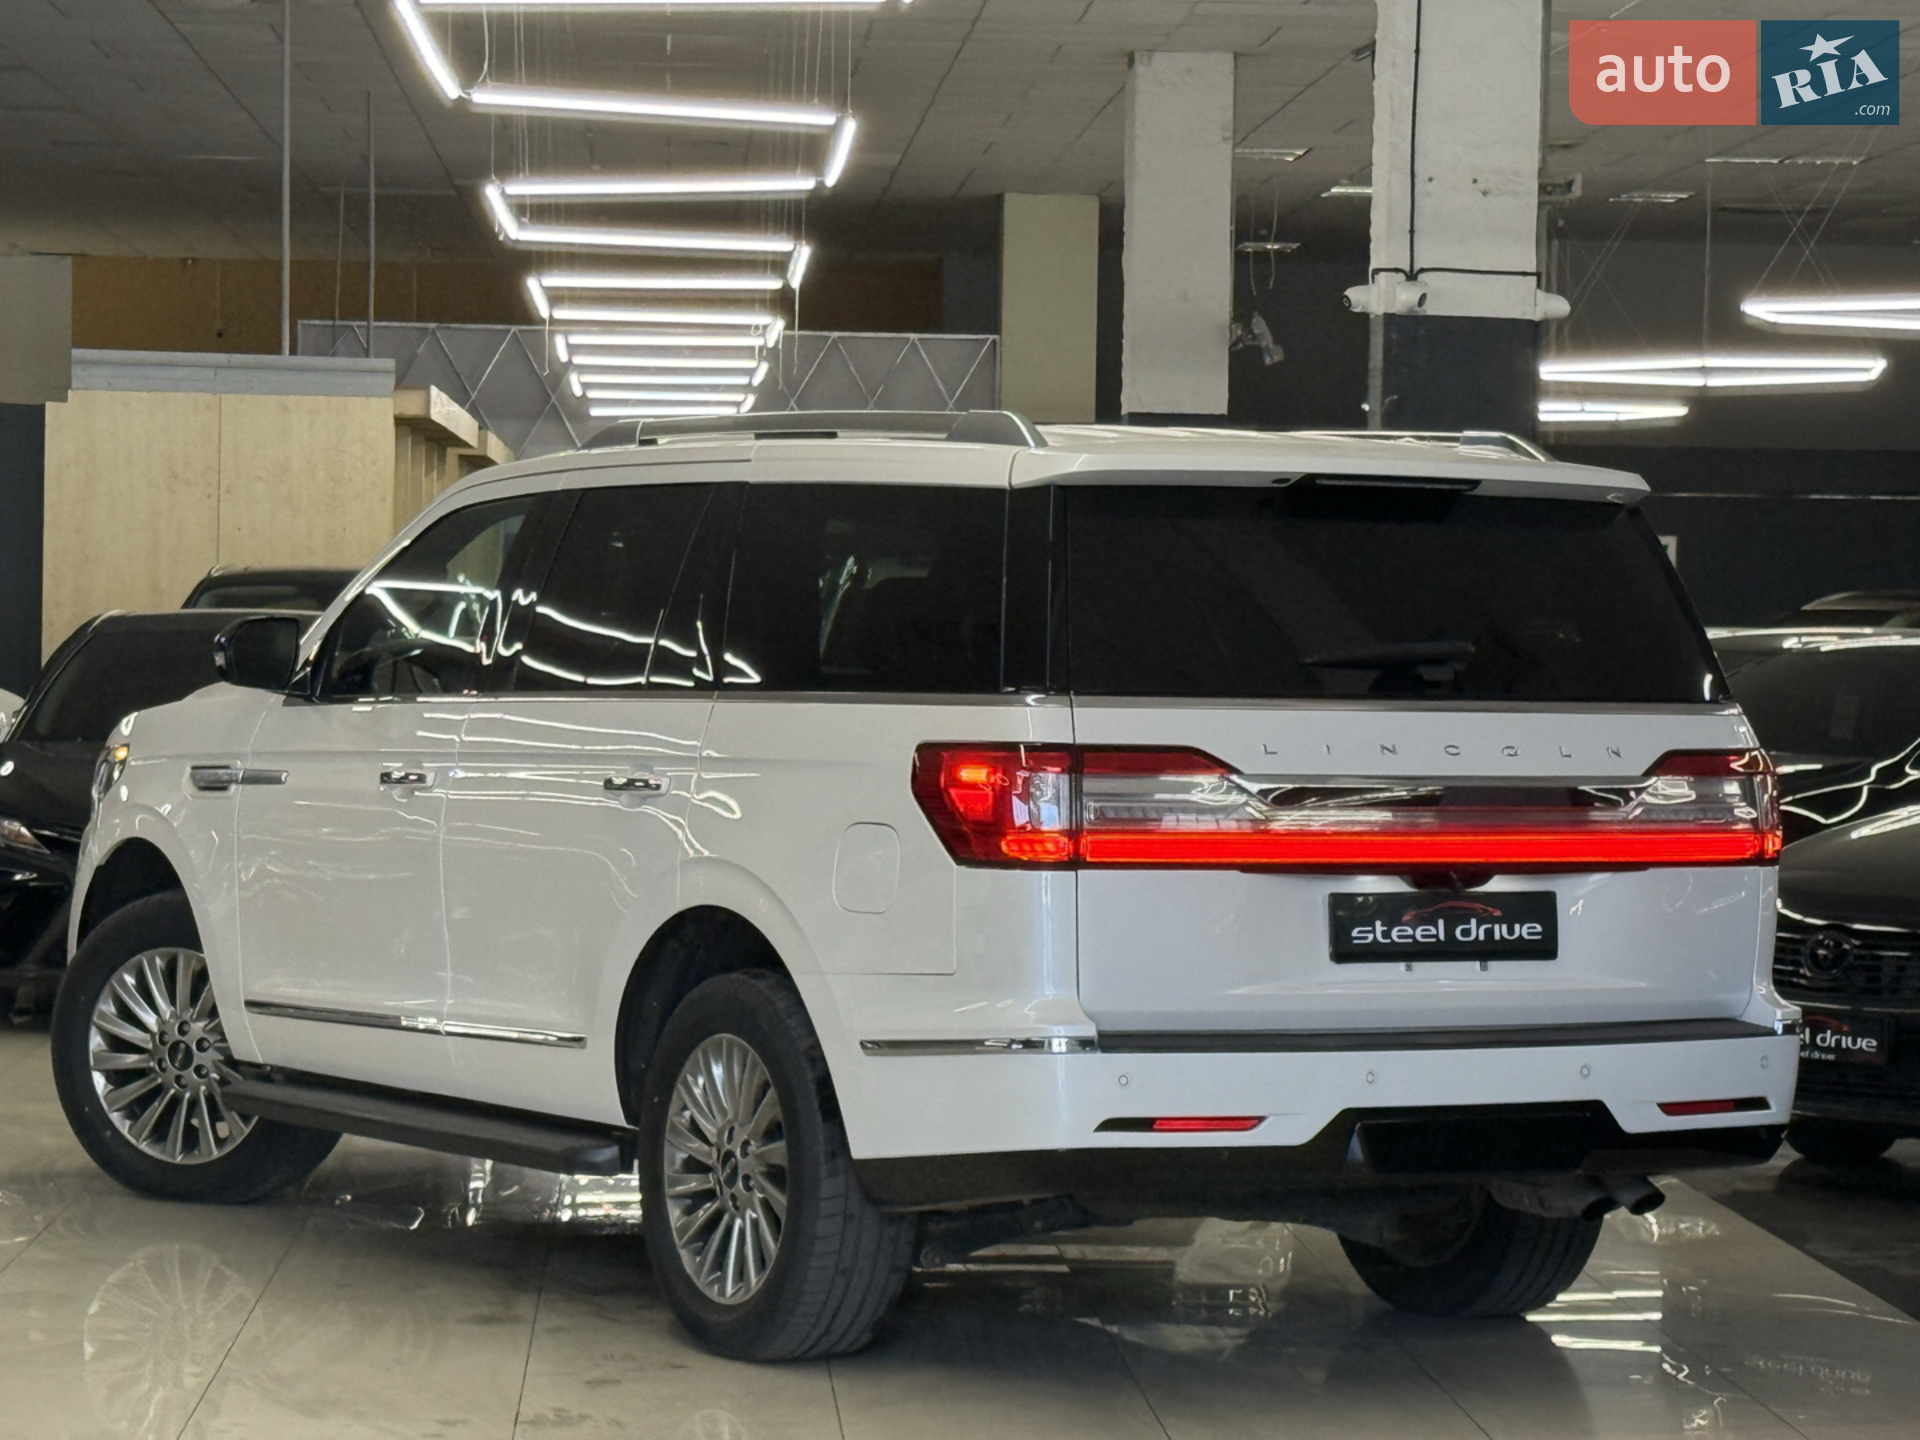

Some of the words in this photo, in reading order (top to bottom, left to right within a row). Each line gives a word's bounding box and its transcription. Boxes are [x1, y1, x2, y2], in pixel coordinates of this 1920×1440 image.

[1262, 742, 1623, 758] LINCOLN
[1351, 918, 1445, 944] steel
[1455, 917, 1543, 942] drive
[1816, 1029, 1878, 1052] drive
